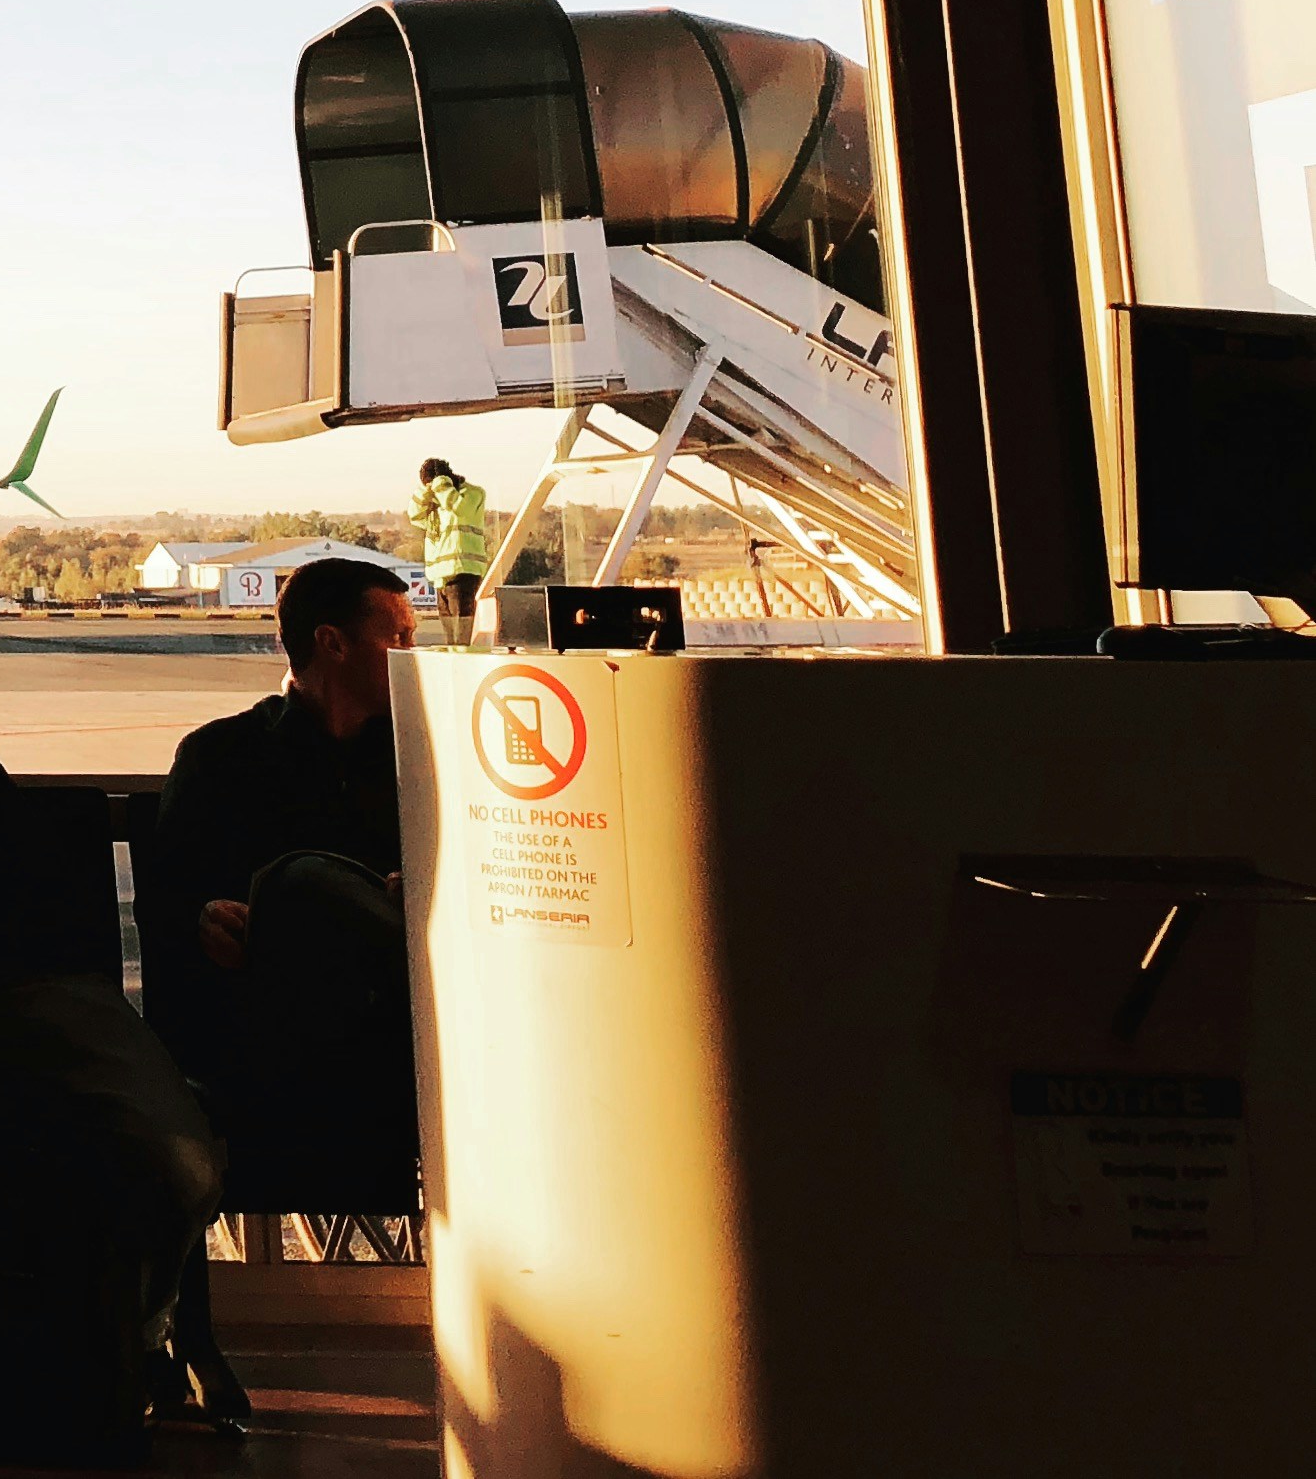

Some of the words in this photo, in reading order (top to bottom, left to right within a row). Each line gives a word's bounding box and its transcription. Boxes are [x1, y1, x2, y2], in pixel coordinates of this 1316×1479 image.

[807, 347, 894, 406] INTER
[469, 804, 488, 821] NO
[492, 806, 526, 825] CELL
[530, 809, 608, 829] PHONES
[493, 830, 513, 844] THE
[517, 833, 539, 847] USE
[542, 834, 559, 848] OF
[563, 836, 573, 848] A
[492, 847, 515, 862] CELL
[518, 850, 562, 865] PHONE
[565, 853, 578, 866] IS
[481, 863, 544, 881] PROHIBITED
[546, 870, 568, 883] ON
[570, 871, 597, 885] THE
[488, 881, 525, 897] APRON
[535, 886, 590, 902] TARMAC
[506, 907, 590, 924] LANSERIA
[1047, 1080, 1208, 1114] NOTICE
